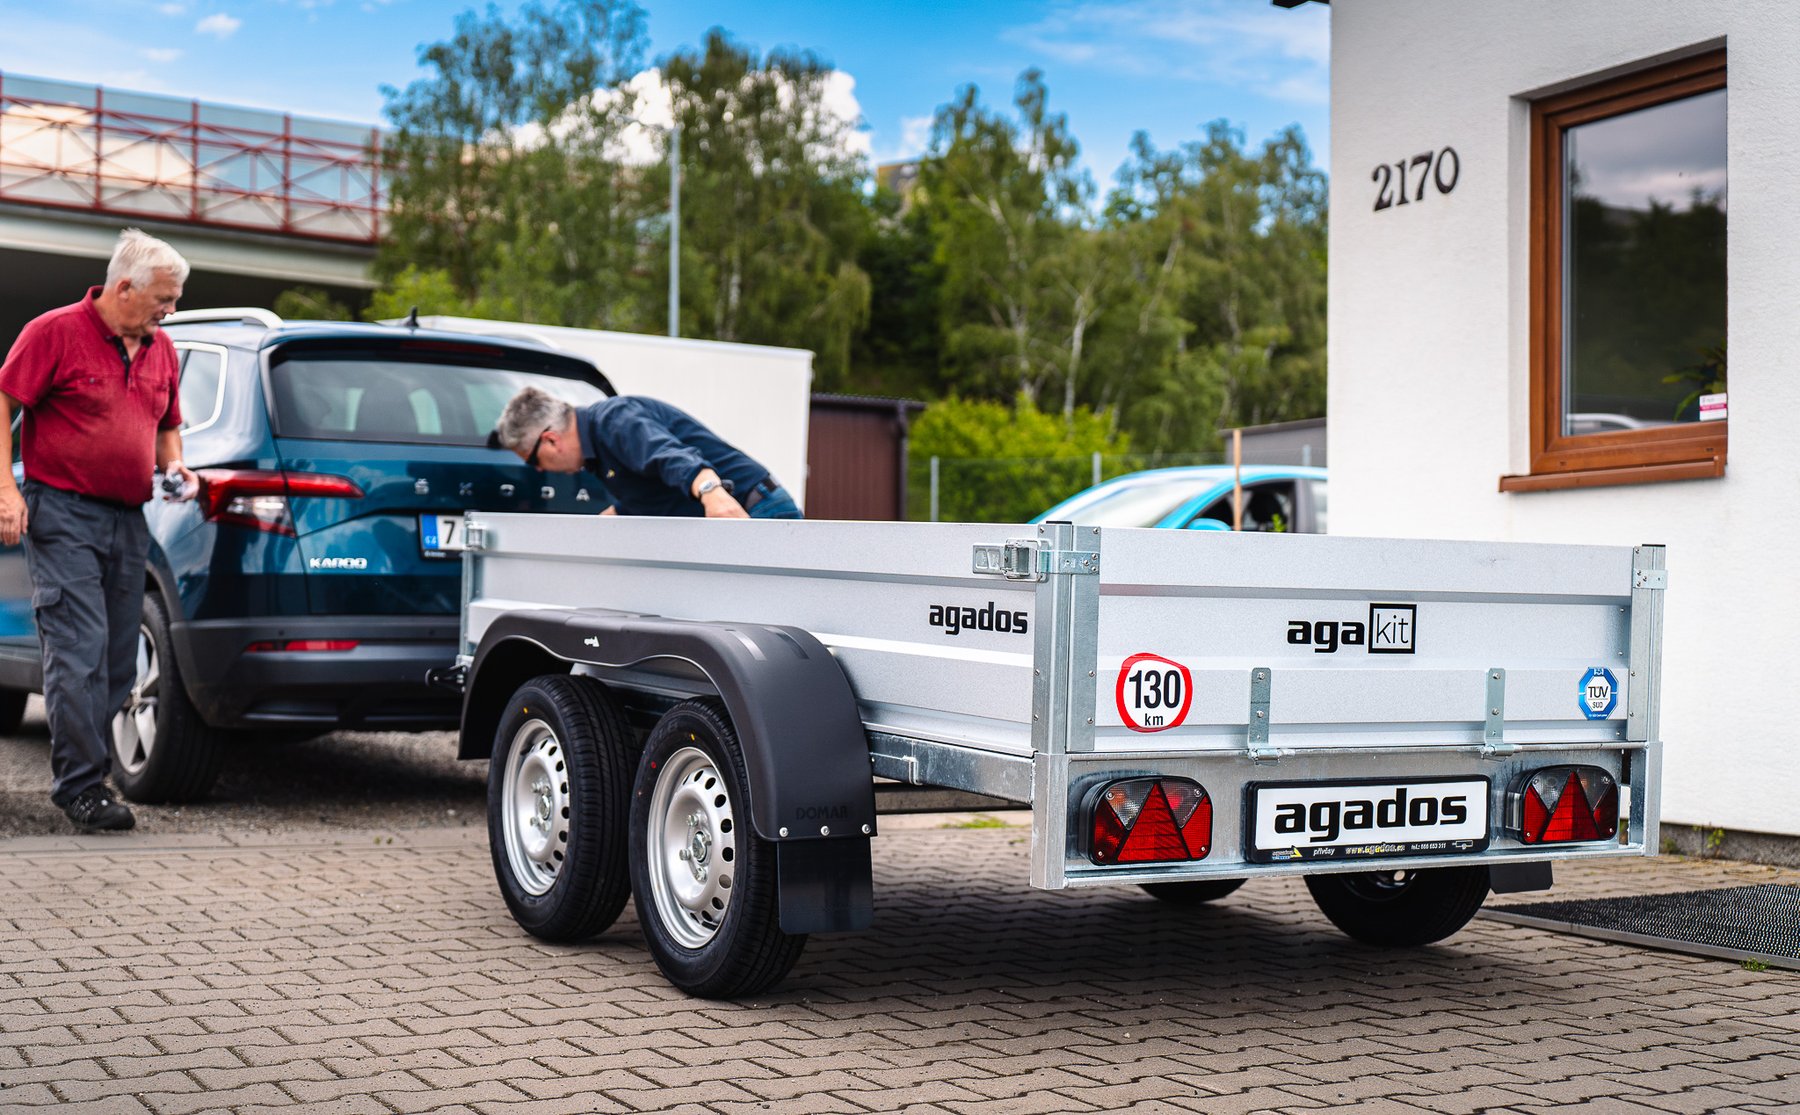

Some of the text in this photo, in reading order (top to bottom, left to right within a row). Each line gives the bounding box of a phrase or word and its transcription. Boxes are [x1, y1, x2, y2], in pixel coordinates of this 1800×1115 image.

[1371, 145, 1460, 213] 2170
[929, 601, 1028, 636] agados
[1128, 669, 1181, 709] 130
[1144, 713, 1164, 726] km
[1274, 788, 1468, 843] agados
